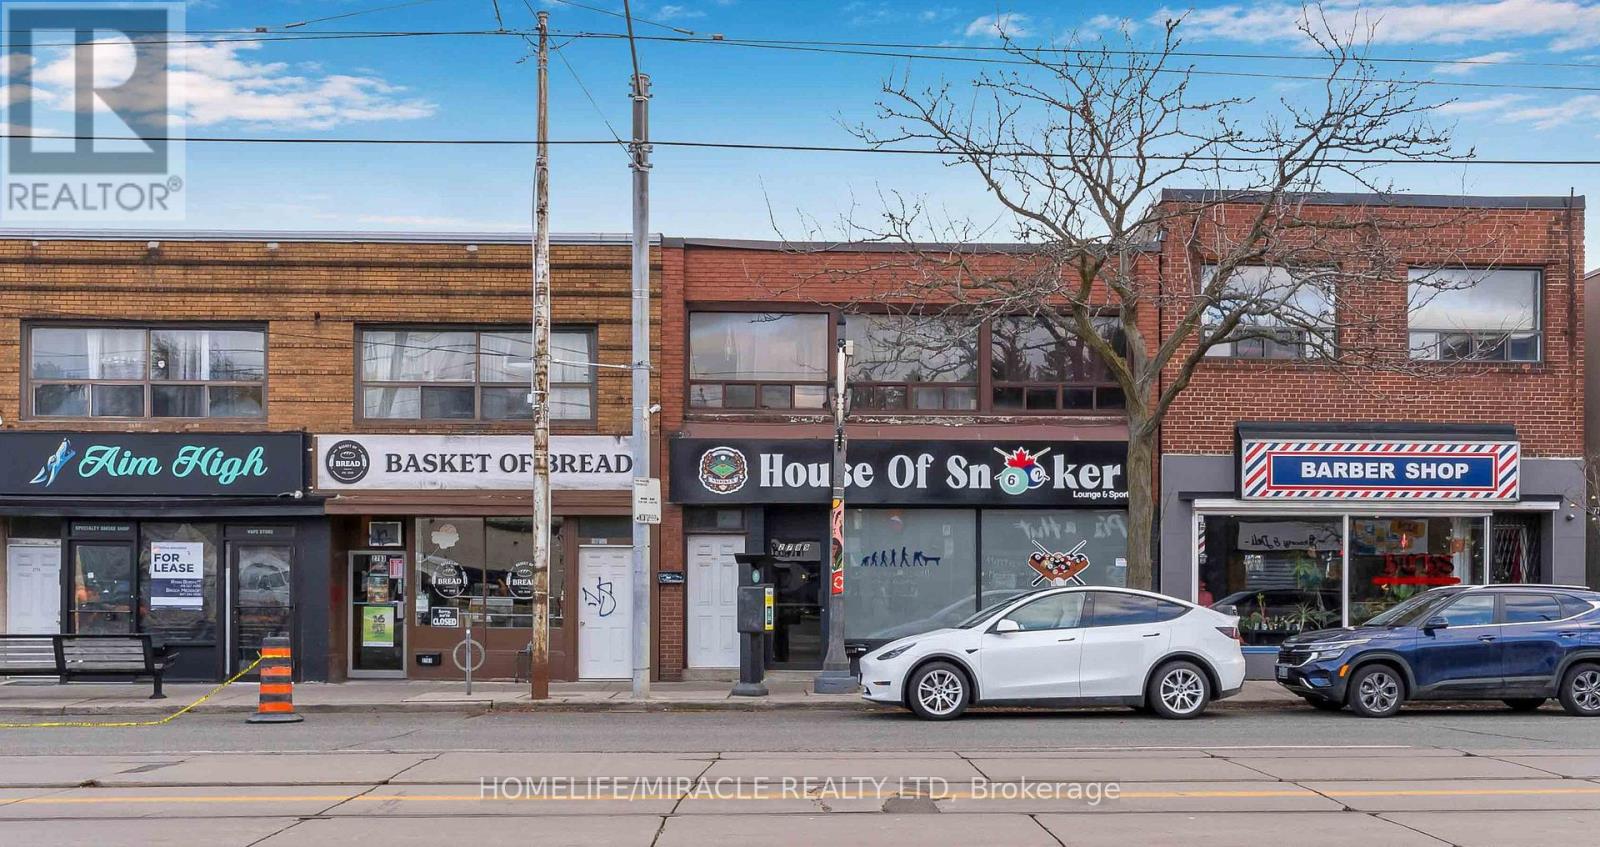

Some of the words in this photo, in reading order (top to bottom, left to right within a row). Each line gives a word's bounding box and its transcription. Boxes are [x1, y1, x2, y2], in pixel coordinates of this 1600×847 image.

[78, 445, 162, 478] Aim
[171, 445, 268, 485] High
[385, 453, 492, 473] BASKET
[499, 453, 534, 474] OF
[887, 454, 934, 489] Of
[1300, 462, 1396, 479] BARBER
[1405, 463, 1469, 479] SHOP
[1073, 490, 1101, 500] Lounge
[154, 553, 180, 562] FOR
[154, 563, 194, 573] LEASE
[432, 617, 457, 626] CLOSED
